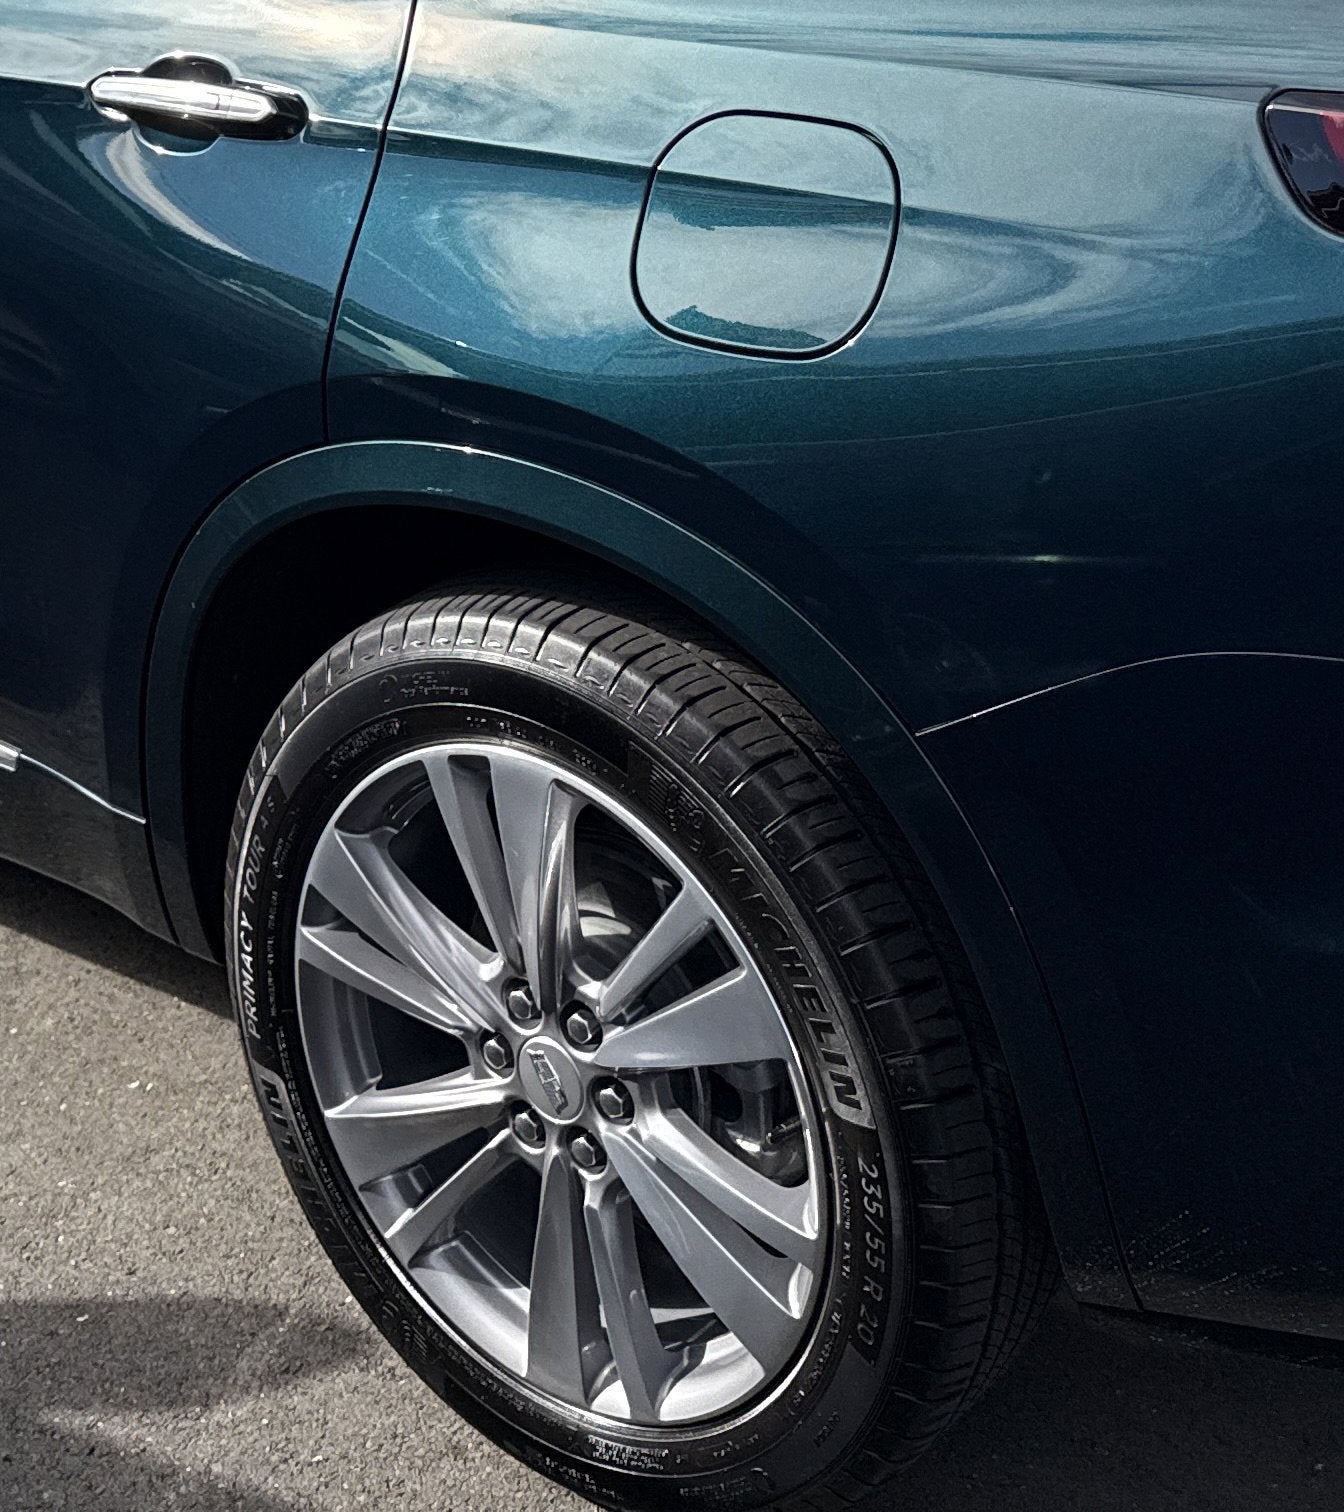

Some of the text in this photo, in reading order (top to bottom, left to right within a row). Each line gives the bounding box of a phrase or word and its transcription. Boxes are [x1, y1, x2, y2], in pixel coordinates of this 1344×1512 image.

[243, 834, 266, 904] TOUR
[239, 910, 262, 1039] PRIMACY
[708, 847, 863, 1112] MICHELIN
[856, 1153, 886, 1346] 235/55 R 20
